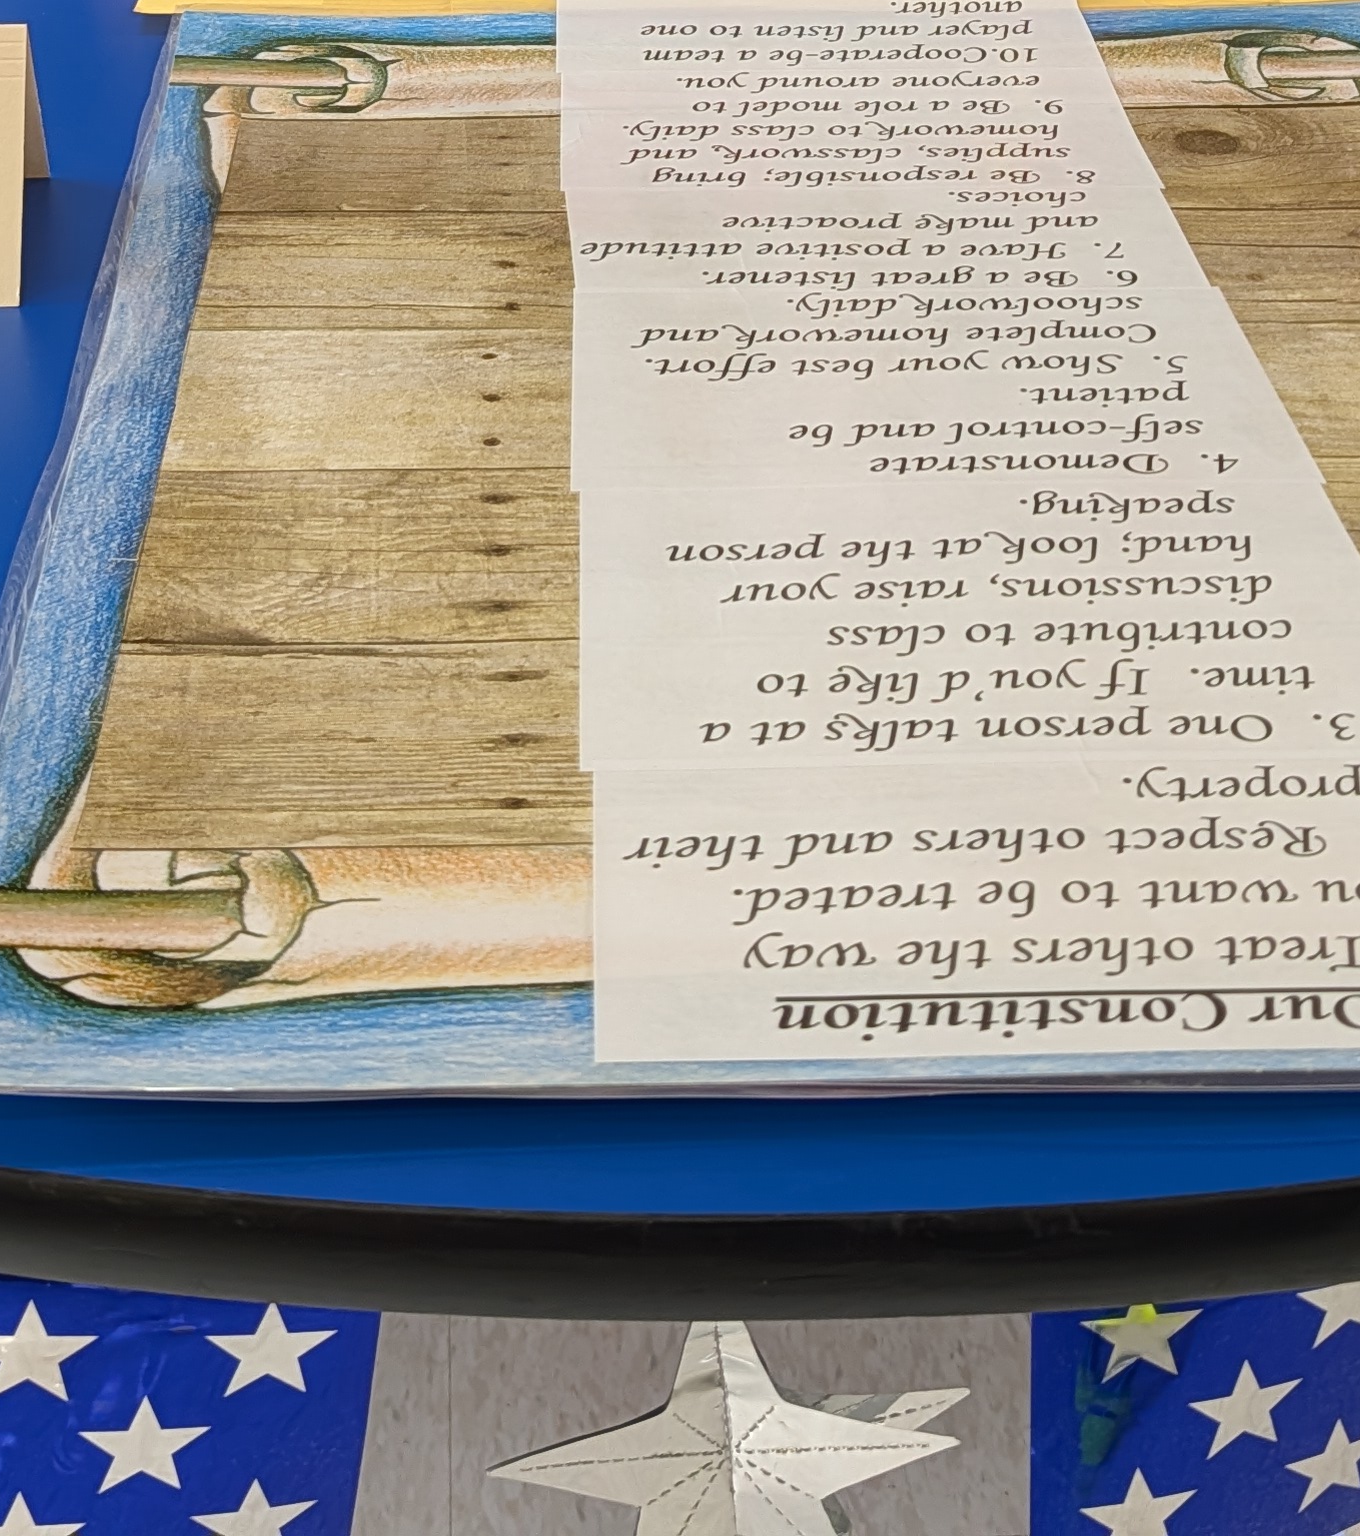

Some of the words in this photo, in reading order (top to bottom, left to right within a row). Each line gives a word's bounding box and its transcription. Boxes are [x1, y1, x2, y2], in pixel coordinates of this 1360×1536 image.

[890, 0, 1023, 19] another.
[640, 24, 698, 36] one
[709, 24, 743, 39] to
[753, 25, 845, 43] listen
[850, 25, 919, 42] and
[927, 19, 1033, 41] player
[643, 49, 725, 63] team
[737, 49, 758, 61] a
[579, 242, 743, 262] attitude
[755, 237, 911, 261] positive
[922, 244, 946, 257] a
[960, 242, 1066, 262] Have
[1094, 242, 1124, 259] 7.
[702, 270, 856, 292] listener.
[871, 265, 976, 288] great
[985, 271, 1010, 285] a
[1023, 270, 1079, 288] Be
[1106, 270, 1138, 288] 6.
[869, 453, 1169, 476] Demonstrate
[1200, 453, 1239, 475] 4.
[826, 624, 946, 657] class
[965, 623, 1016, 647] to
[1034, 619, 1292, 653] contribute
[756, 673, 809, 698] to
[828, 665, 919, 705] like
[1093, 657, 1150, 701] If
[1190, 665, 1315, 696] time.
[699, 722, 732, 744] a
[750, 721, 806, 746] at
[824, 712, 959, 753] talks
[975, 705, 1152, 738] person
[1168, 714, 1273, 743] One
[1312, 712, 1356, 741] 3.
[912, 827, 1086, 863] others
[1105, 815, 1327, 858] Respect
[622, 834, 764, 871] their
[773, 831, 893, 870] and
[732, 881, 956, 926] treated.
[978, 880, 1036, 919] be
[1060, 880, 1120, 909] to
[1138, 879, 1299, 909] want
[743, 931, 877, 969] way
[897, 938, 992, 980] the
[1012, 936, 1194, 977] others
[771, 990, 1228, 1044] Constitution
